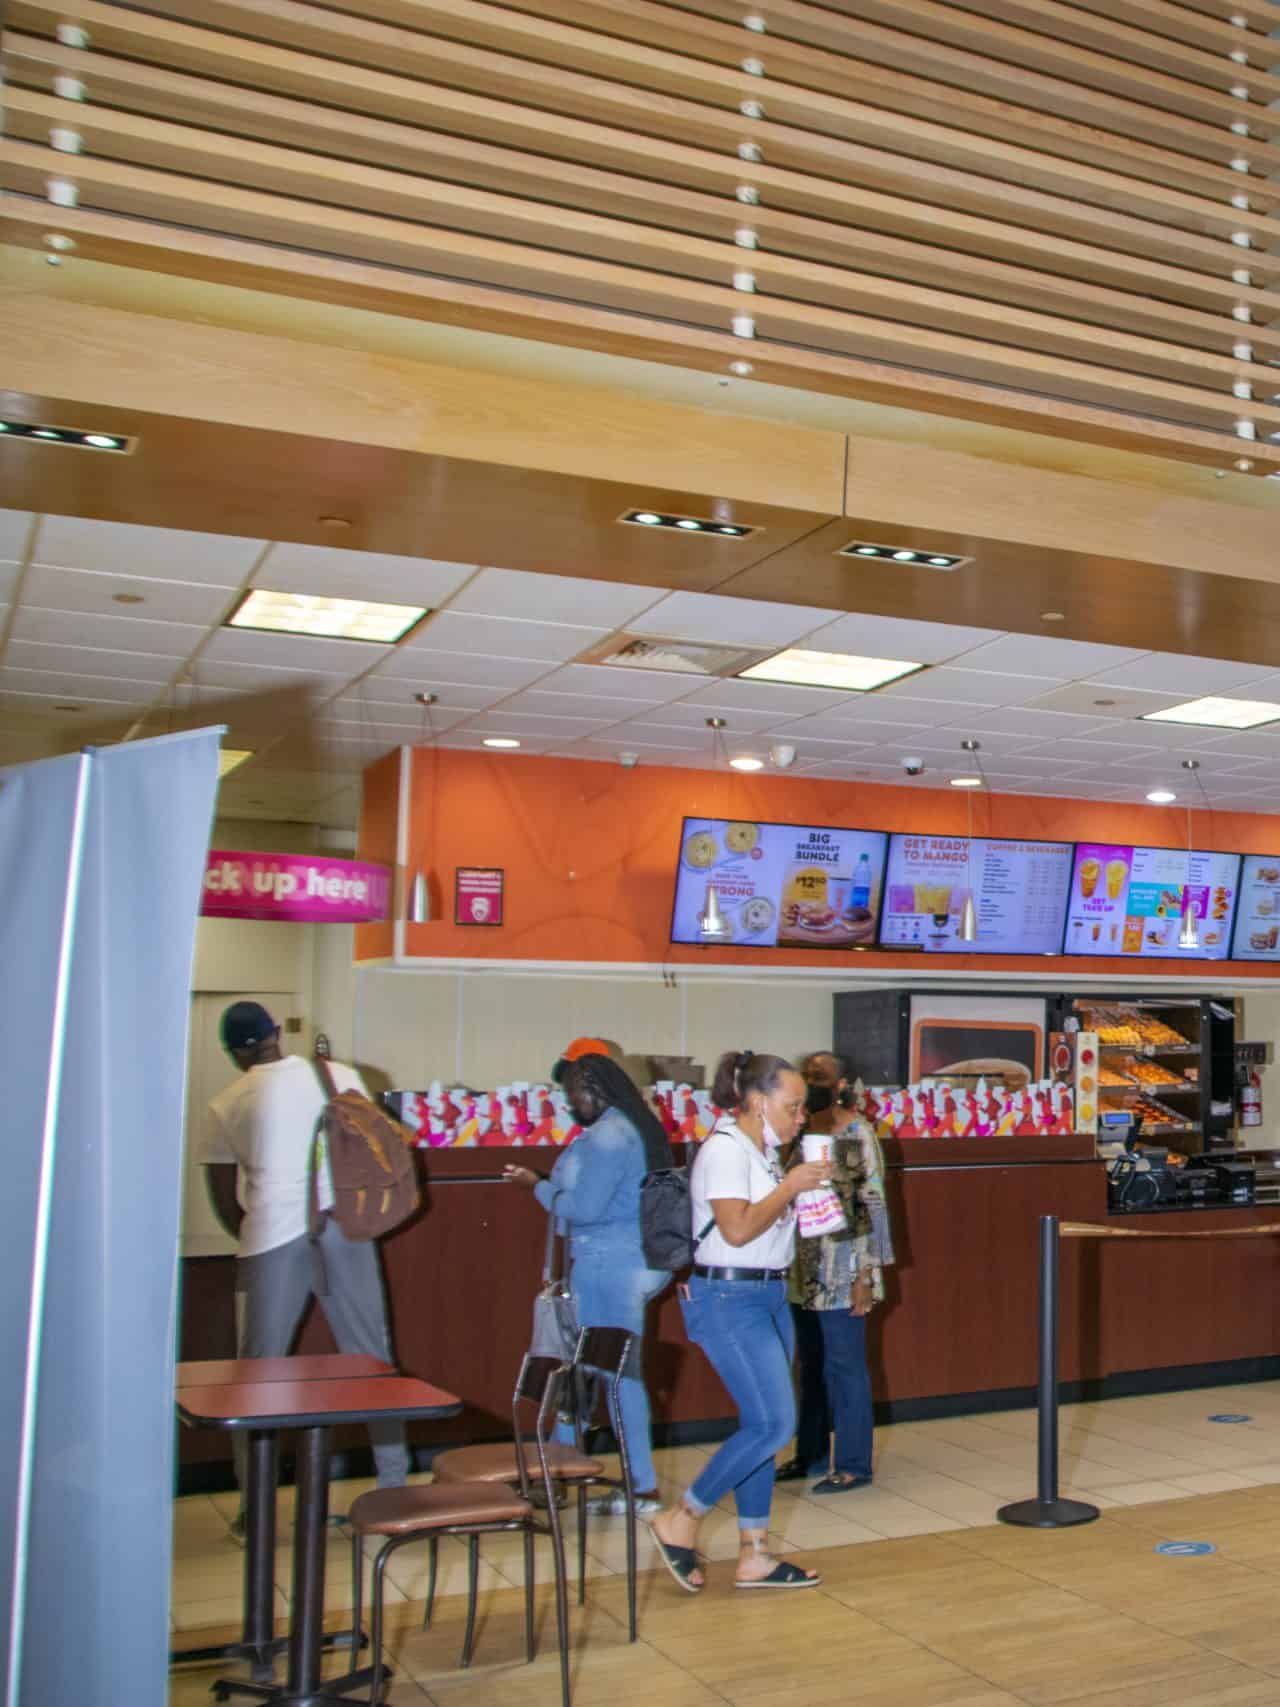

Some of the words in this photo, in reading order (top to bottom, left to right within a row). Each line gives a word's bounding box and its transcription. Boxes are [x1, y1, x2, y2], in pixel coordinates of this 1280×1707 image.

[809, 832, 831, 844] BIG
[254, 871, 296, 902] up
[307, 867, 368, 900] here
